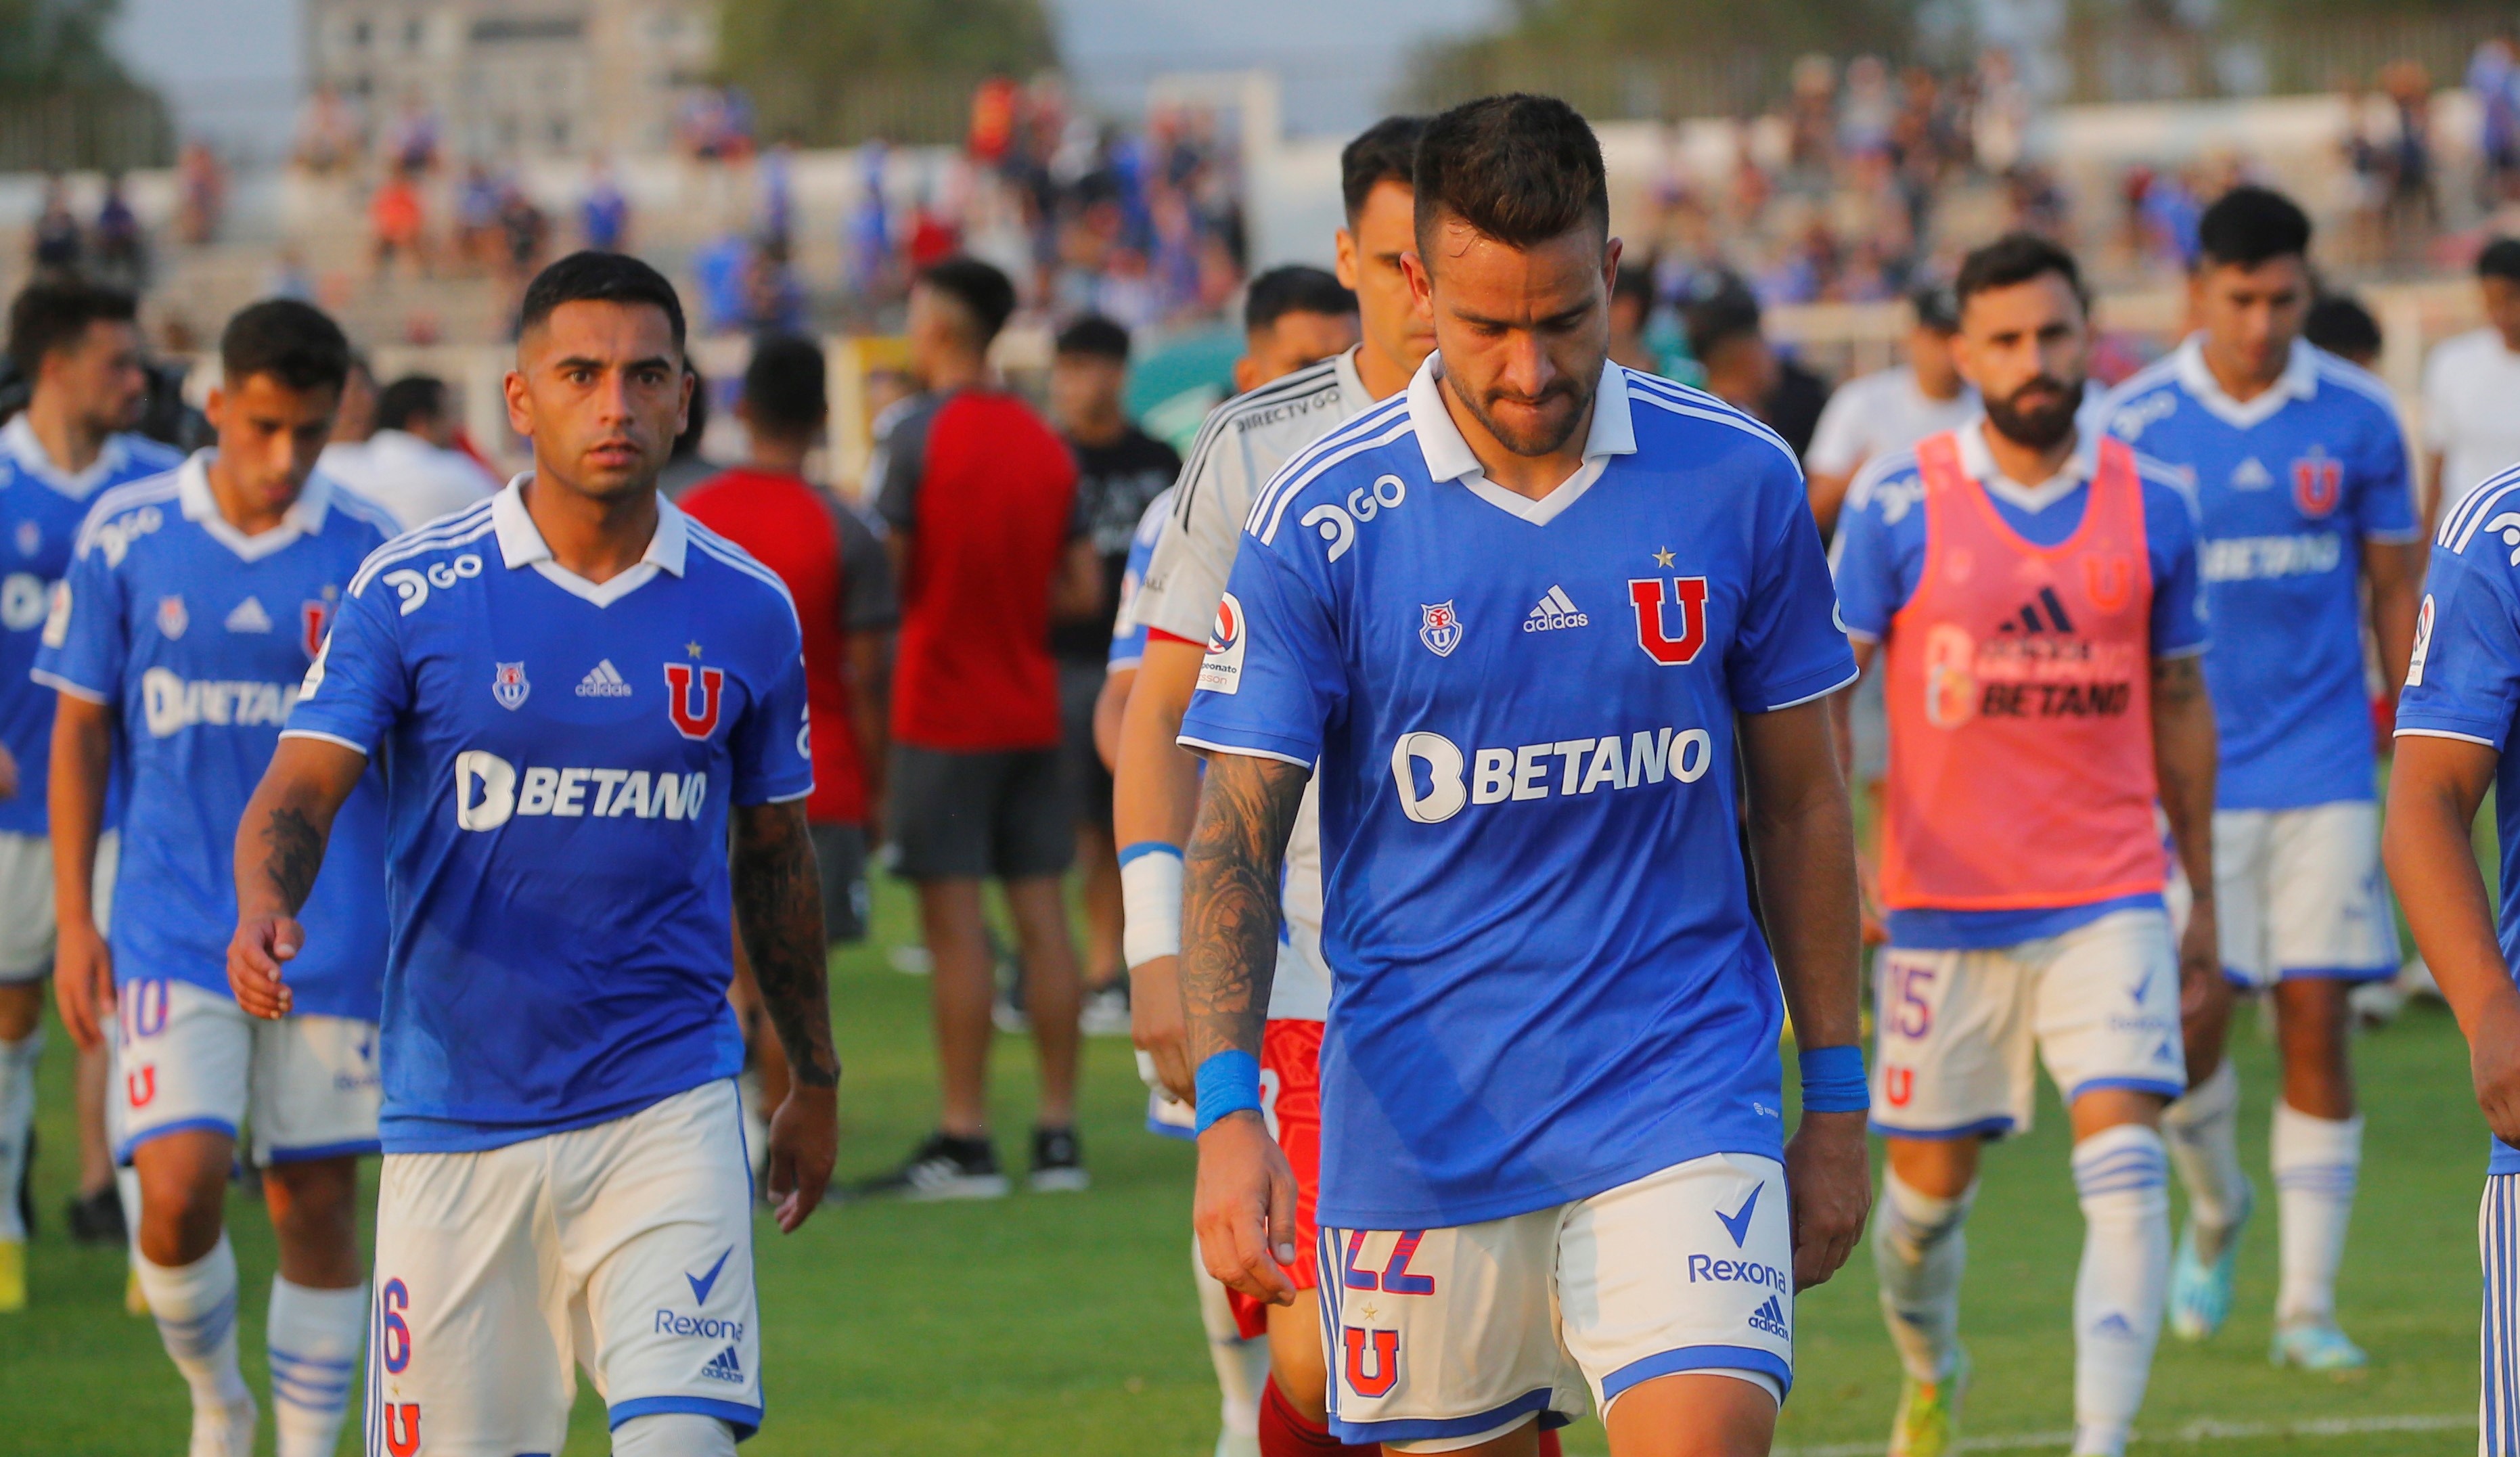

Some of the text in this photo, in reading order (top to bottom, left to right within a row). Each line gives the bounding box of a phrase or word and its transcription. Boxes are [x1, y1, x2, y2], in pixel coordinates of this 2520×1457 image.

[1236, 389, 1339, 432] DIRECTV GO
[1523, 612, 1588, 633] adidas
[1627, 576, 1709, 667] U
[575, 683, 632, 697] adidas
[663, 662, 724, 741] U
[1472, 727, 1711, 805] BETANO
[516, 767, 706, 820] BETANO
[1688, 1254, 1786, 1295] Rexona
[384, 1277, 411, 1374] 6
[654, 1309, 743, 1343] Rexona
[1748, 1316, 1790, 1342] adidas
[701, 1364, 744, 1383] adidas
[1343, 1326, 1400, 1398] U
[385, 1404, 421, 1457] U
